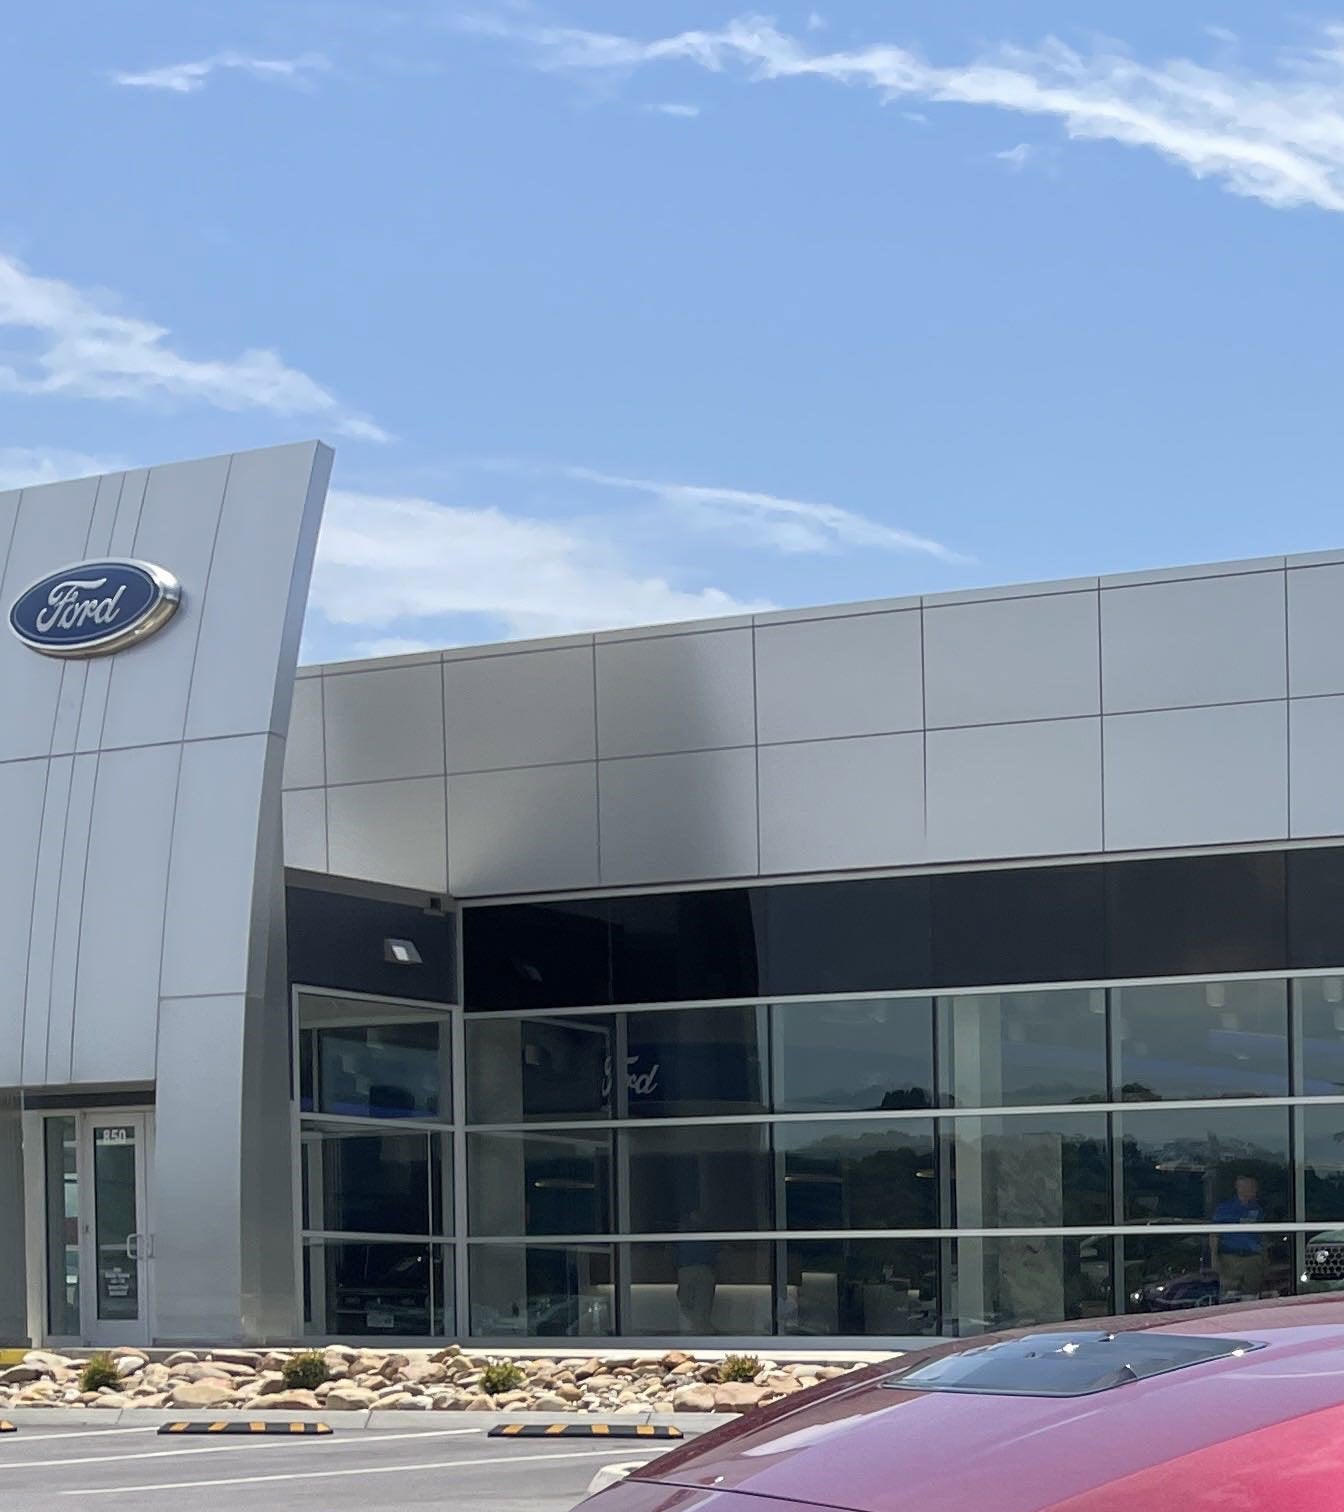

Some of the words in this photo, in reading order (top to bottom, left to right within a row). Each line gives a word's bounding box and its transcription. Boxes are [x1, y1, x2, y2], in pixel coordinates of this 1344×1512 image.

[35, 577, 127, 633] Ford
[602, 1055, 660, 1097] Frd
[103, 1129, 126, 1144] 850
